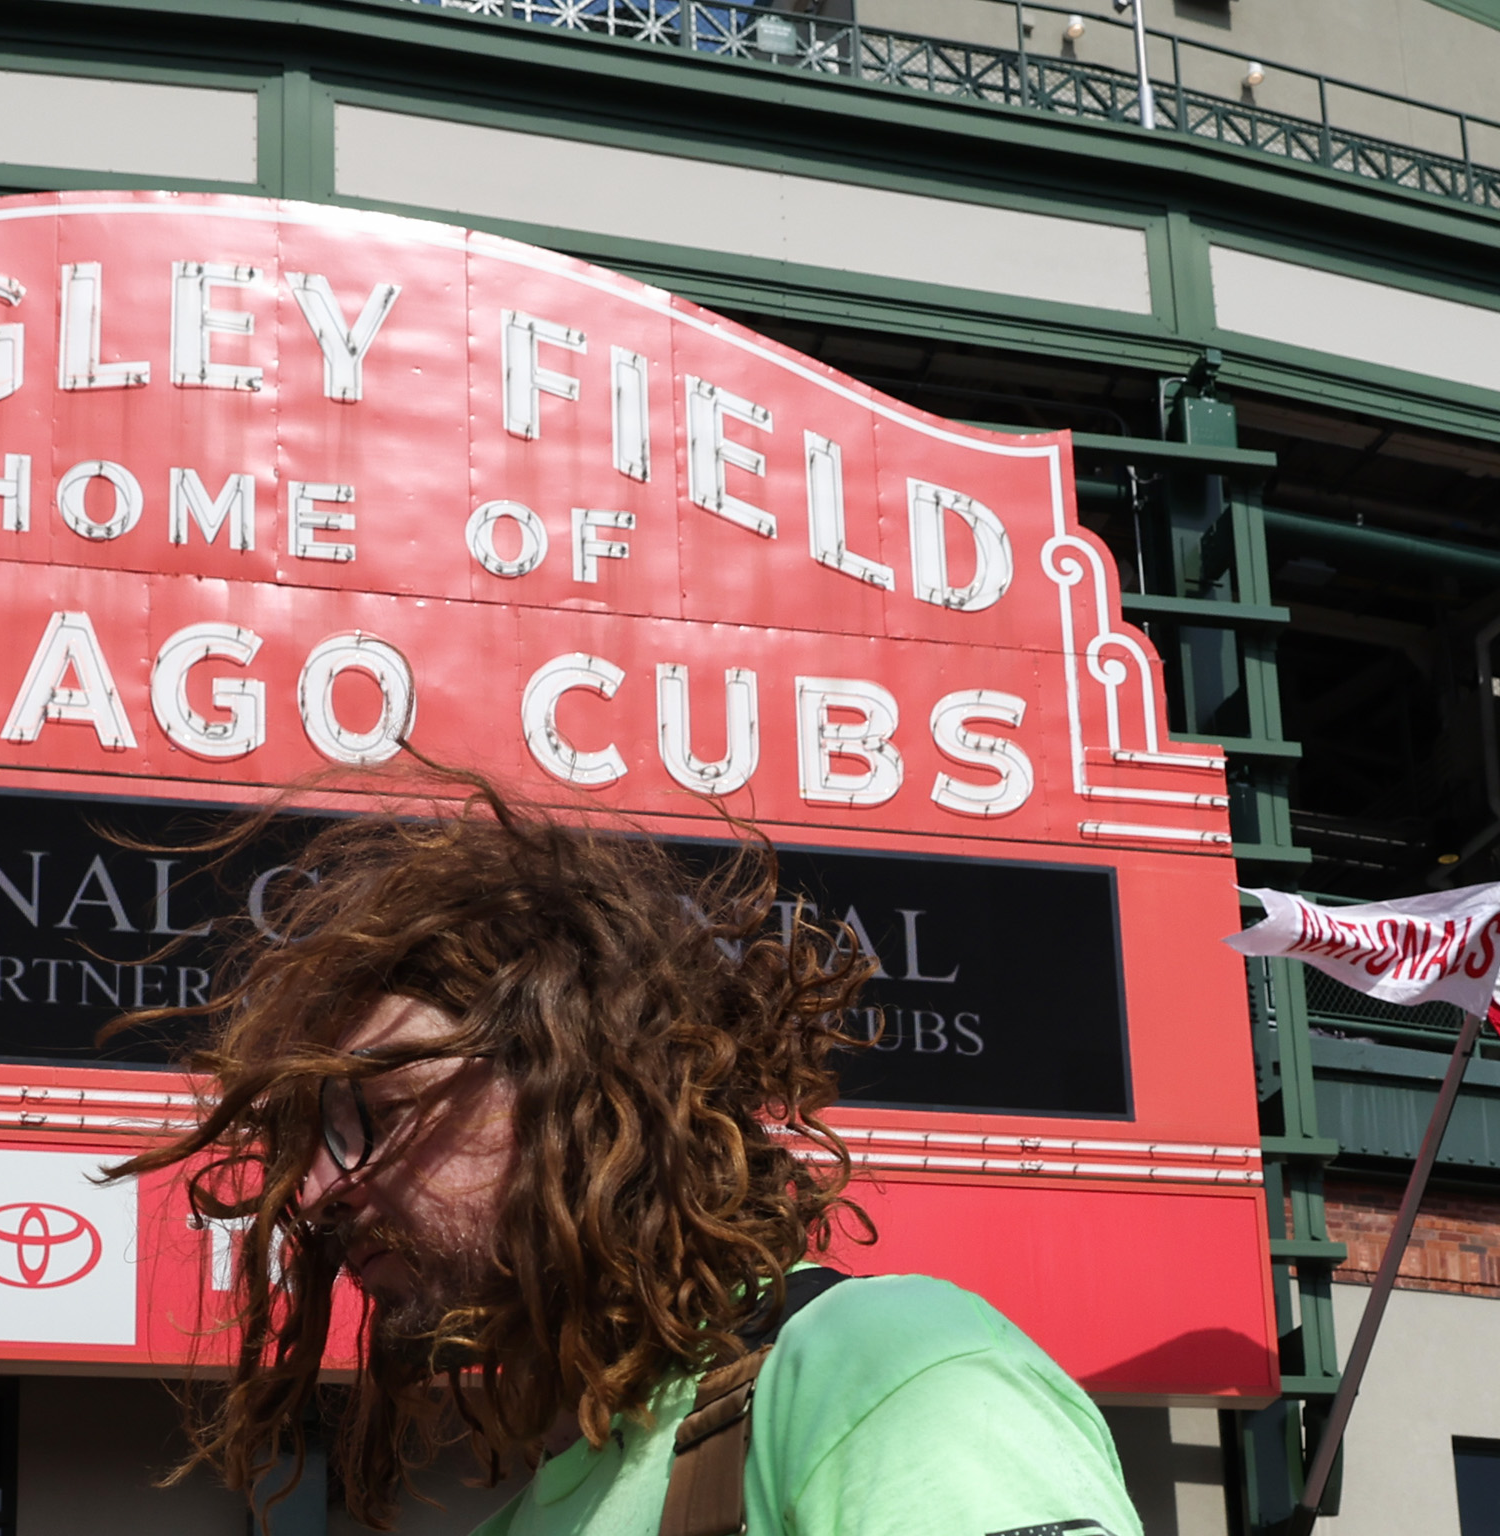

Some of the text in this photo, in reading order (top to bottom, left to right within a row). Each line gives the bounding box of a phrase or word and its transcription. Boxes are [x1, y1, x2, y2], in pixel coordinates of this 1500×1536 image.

[465, 499, 637, 584] OF
[501, 308, 1014, 613] FIELD
[521, 652, 1035, 819] CUBS
